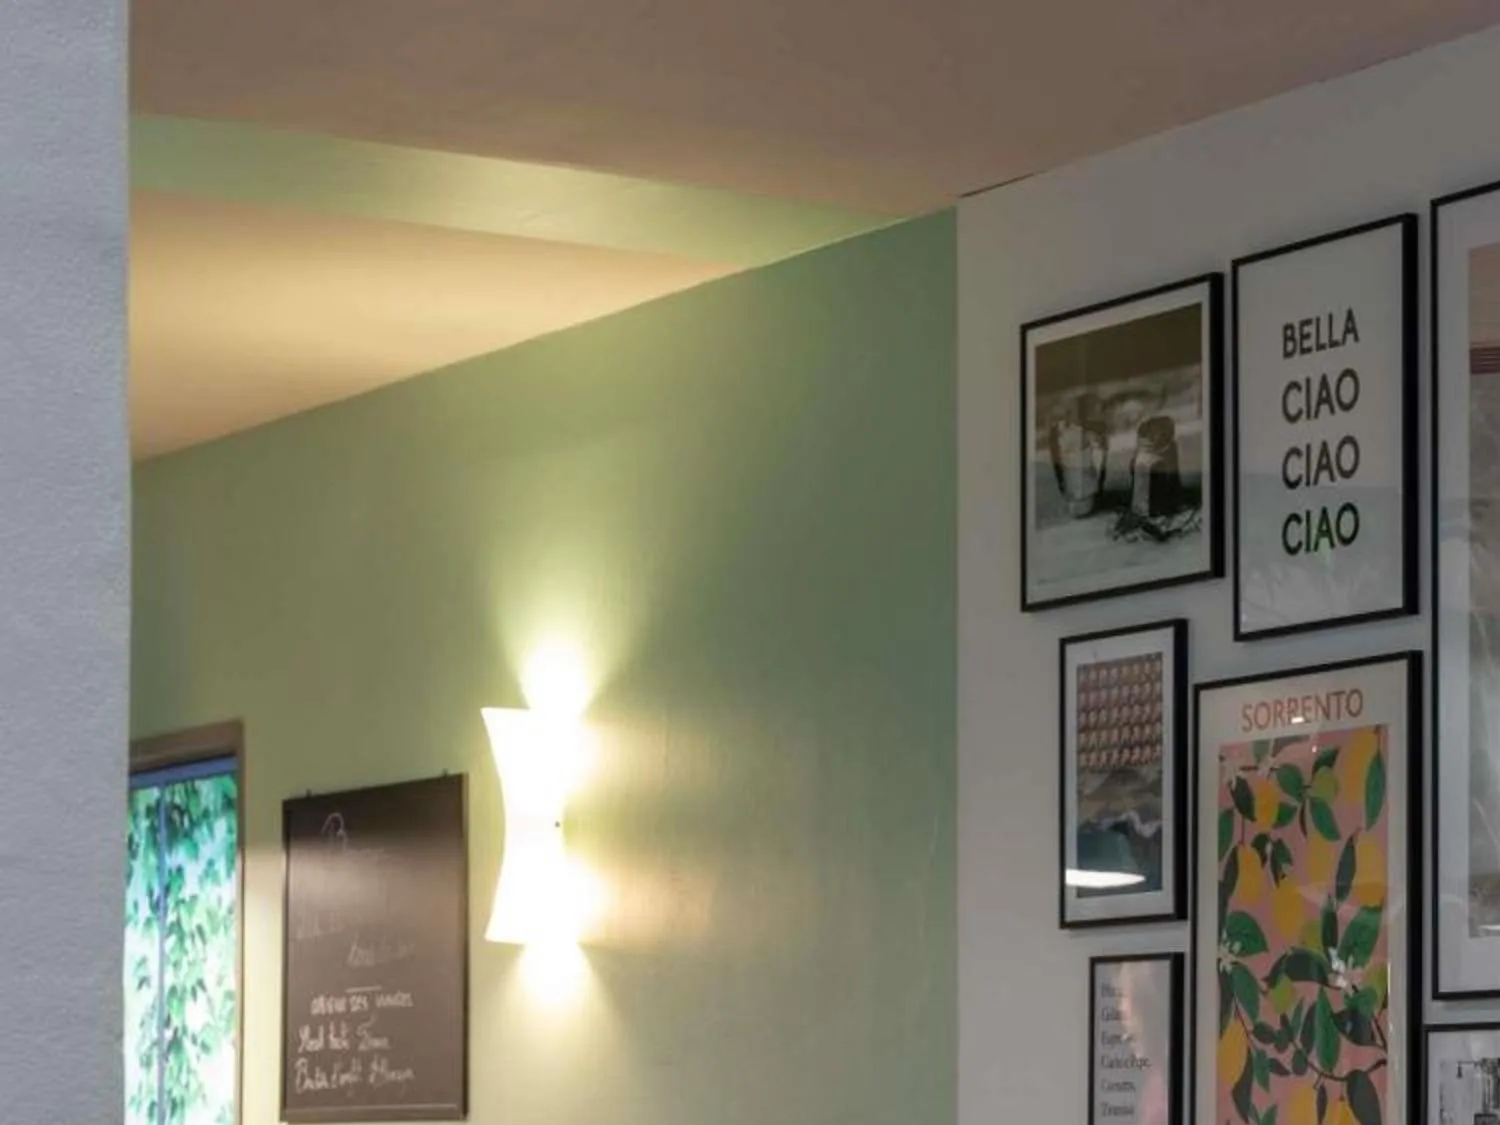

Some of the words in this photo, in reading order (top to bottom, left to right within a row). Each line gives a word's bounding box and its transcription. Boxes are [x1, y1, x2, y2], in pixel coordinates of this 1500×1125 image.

[1282, 307, 1360, 359] BELLA
[1282, 367, 1360, 424] CIAO
[1282, 435, 1360, 490] CIAO
[1282, 502, 1360, 556] CIAO
[1241, 688, 1364, 733] SORRENTO
